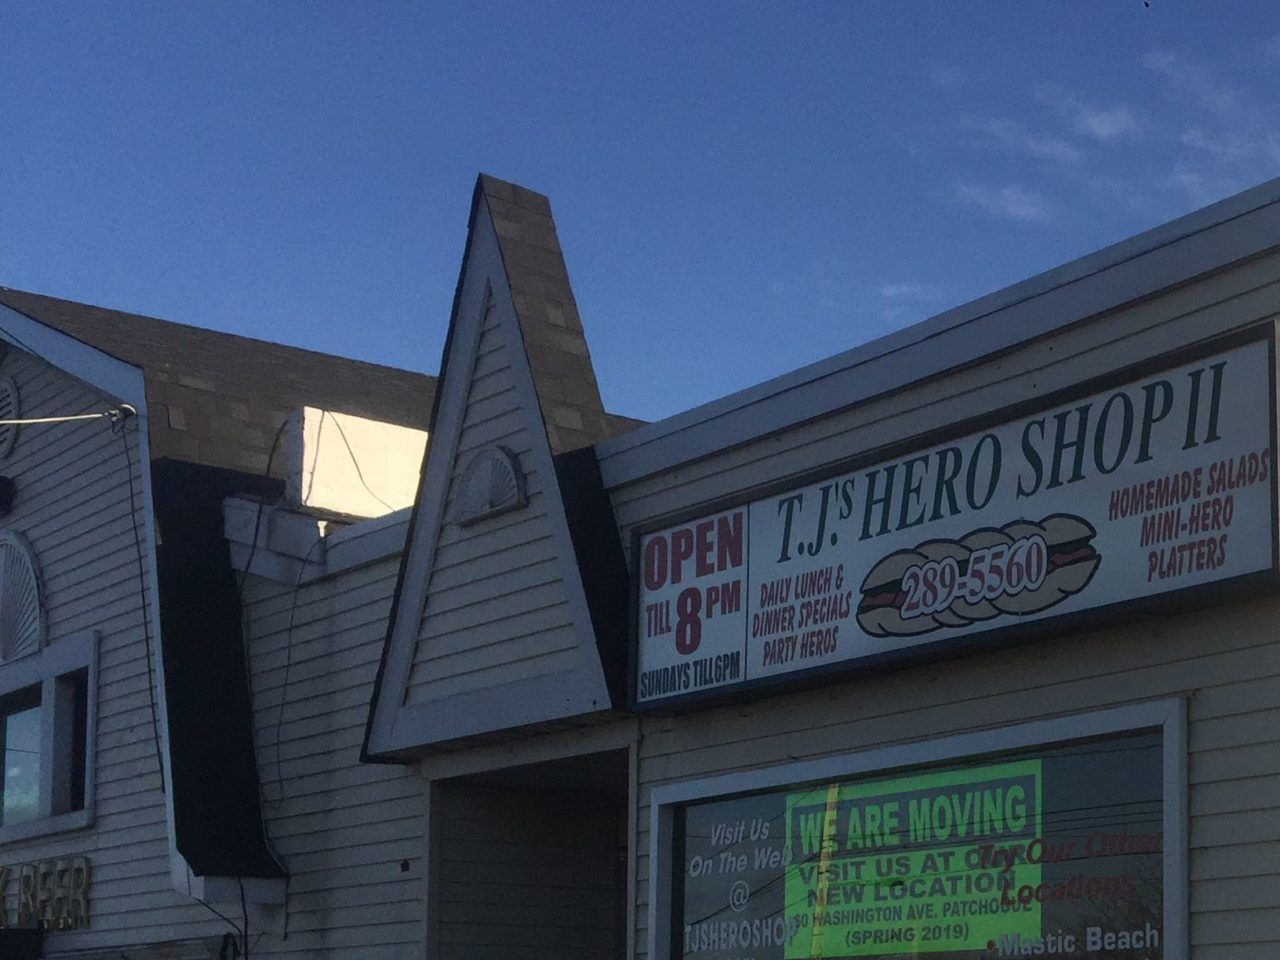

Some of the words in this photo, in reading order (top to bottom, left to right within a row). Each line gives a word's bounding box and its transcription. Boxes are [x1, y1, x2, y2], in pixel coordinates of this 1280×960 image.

[859, 434, 1001, 541] HERO
[1016, 379, 1174, 500] SHOP
[1182, 362, 1225, 450] II
[1109, 468, 1202, 521] HOMEMADE
[1207, 448, 1270, 495] SALADS
[1140, 495, 1233, 548] MINI-HERO
[645, 512, 743, 591] OPEN
[1147, 534, 1227, 582] PLATTERS
[760, 577, 792, 608] DAILY
[794, 566, 832, 600] LUNCH
[835, 563, 844, 590] &
[902, 538, 1045, 615] 289-5560
[646, 600, 671, 638] TILL
[752, 604, 795, 638] DINNER
[798, 590, 853, 629] SPECIALS
[762, 635, 798, 666] PARTY
[799, 625, 839, 660] HEROS
[640, 661, 690, 699] SUNDAYS
[711, 821, 745, 846] Visit
[750, 819, 769, 841] Us
[799, 810, 838, 856] WE
[846, 801, 900, 851] ARE
[908, 785, 1027, 841] MOVING
[688, 855, 713, 877] On
[719, 852, 748, 873] The
[754, 846, 794, 872] Web
[875, 855, 911, 878] US
[921, 851, 955, 874] AT
[729, 879, 750, 913] @
[874, 870, 1016, 902] LOCATION
[812, 904, 902, 928] WASHINGTON
[906, 903, 938, 922] AVE.
[943, 898, 1032, 919] PATCHOGUE
[684, 916, 798, 953] TJSHEROSHOP
[845, 927, 915, 948] (SPRING
[921, 922, 970, 942] 2019)
[998, 929, 1077, 956] Mastic
[1086, 922, 1160, 952] Beach
